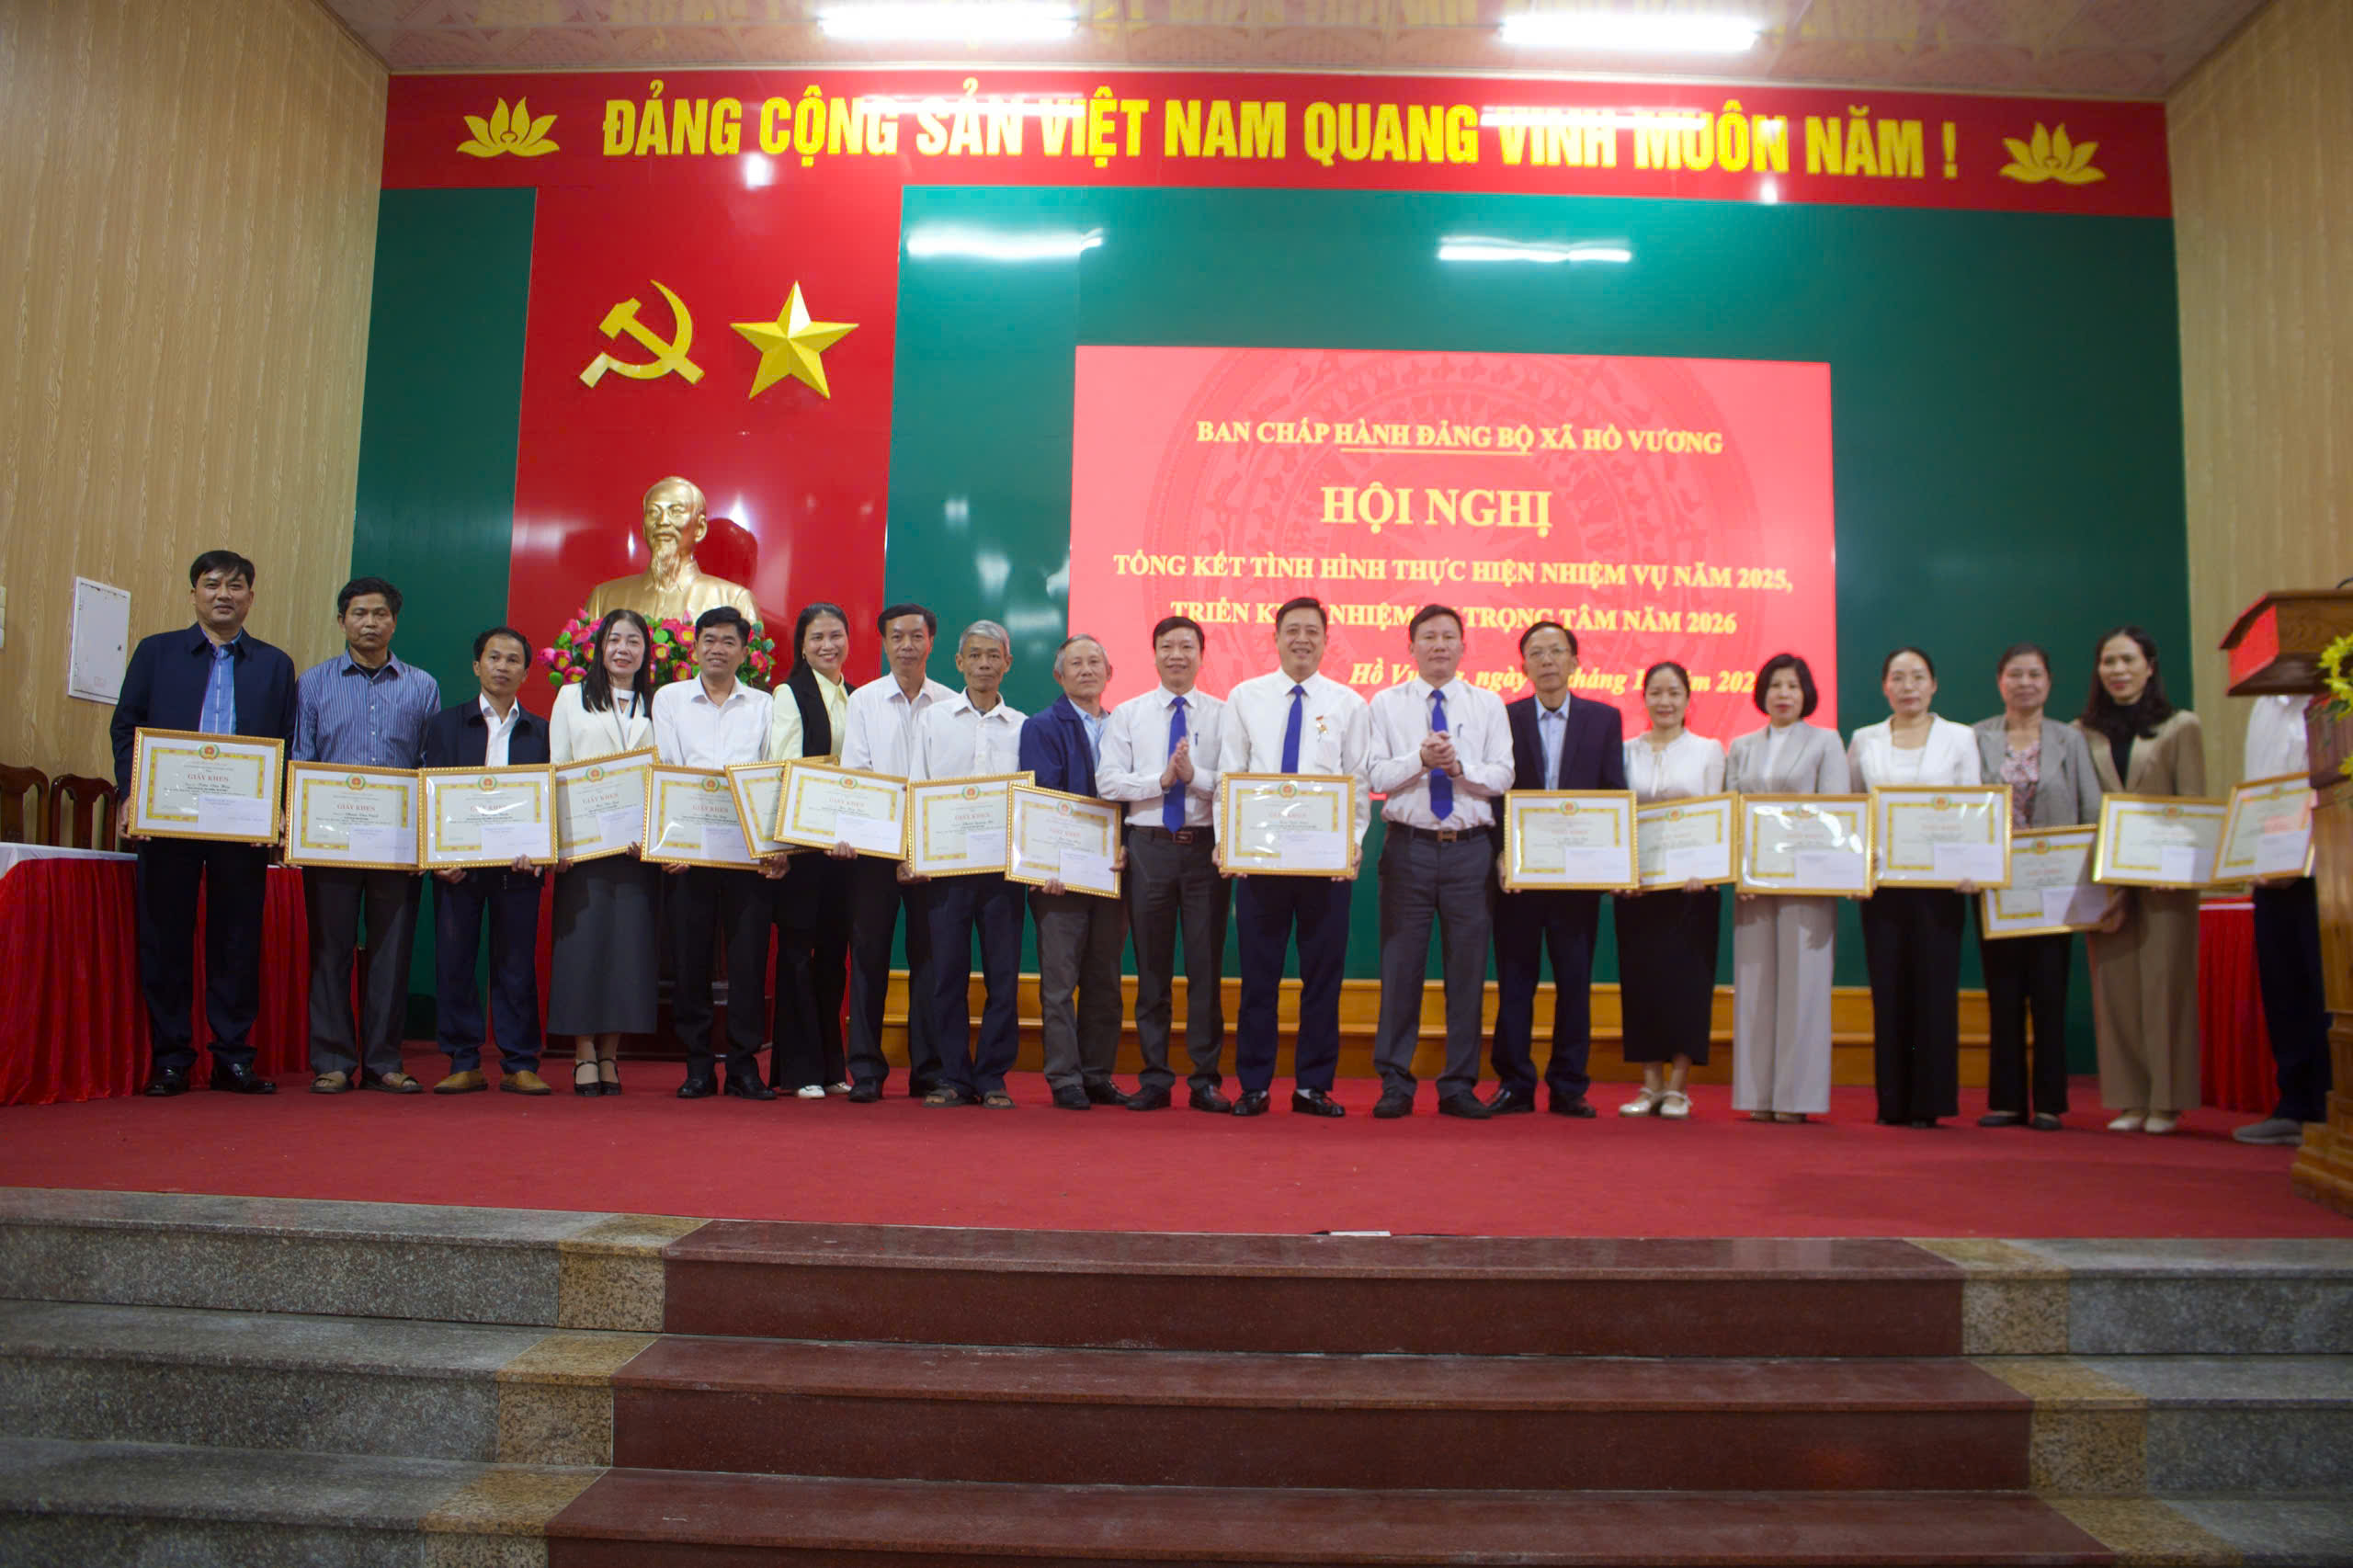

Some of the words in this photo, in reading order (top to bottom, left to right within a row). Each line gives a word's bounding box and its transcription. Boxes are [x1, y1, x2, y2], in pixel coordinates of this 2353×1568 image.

[603, 80, 743, 156] ĐẢNG
[759, 85, 899, 167] CỘNG
[915, 77, 1024, 157] SẢN
[1040, 85, 1149, 167] VIỆT
[1164, 99, 1286, 159] NAM
[1302, 102, 1480, 167] QUANG
[1496, 106, 1618, 168] VINH
[1634, 99, 1790, 174] MUÔN
[1805, 105, 1926, 178] NĂM
[1941, 121, 1959, 177] !
[1198, 419, 1250, 442] BAN
[1256, 418, 1331, 445] CHẤP
[1336, 420, 1412, 446] HÀNH
[1416, 421, 1491, 449] ĐẢNG
[1497, 423, 1534, 452] BỘ
[1540, 424, 1577, 449] XÃ
[1583, 425, 1623, 451] HỒ
[1628, 426, 1723, 454] VƯƠNG
[1321, 482, 1413, 534] HỘI
[1426, 488, 1553, 538] NGHỊ
[1114, 550, 1186, 576] TỔNG
[1193, 551, 1245, 577] KẾT
[1250, 551, 1314, 579] TÌNH
[1321, 552, 1386, 580] HÌNH
[1392, 557, 1467, 584] THỰC
[1472, 557, 1535, 587] HIỆN
[1541, 559, 1626, 588] NHIỆM
[1632, 565, 1668, 592] VỤ
[1674, 562, 1733, 589] NĂM
[1738, 567, 1793, 594] 2025,
[1170, 596, 1248, 624] TRIỂN
[1329, 603, 1417, 631] NHIỆM
[1462, 608, 1554, 632] TRỌNG
[1558, 603, 1618, 631] TÂM
[1623, 607, 1682, 632] NĂM
[1687, 612, 1736, 634] 2026
[1348, 656, 1384, 685] Hồ
[1474, 665, 1529, 693] ngày
